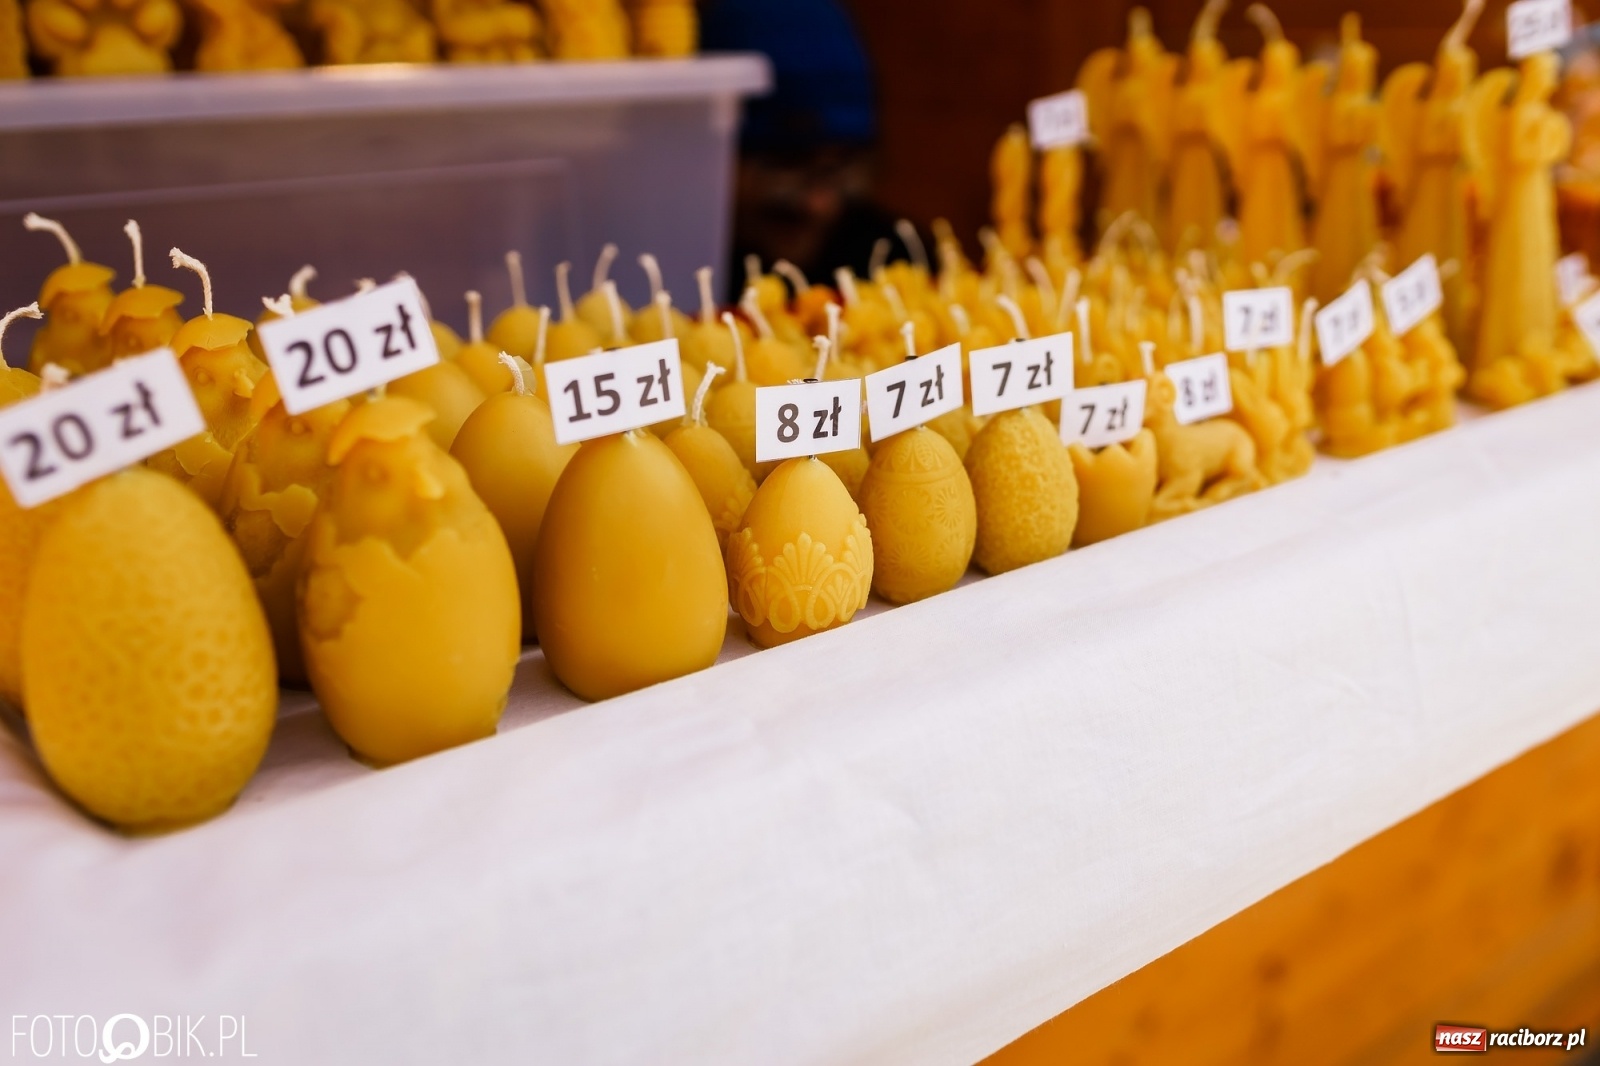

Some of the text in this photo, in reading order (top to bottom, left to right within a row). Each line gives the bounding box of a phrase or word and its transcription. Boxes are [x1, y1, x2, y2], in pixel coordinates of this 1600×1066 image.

[285, 303, 417, 390] 20 zł
[562, 358, 672, 423] 15 zł
[885, 363, 945, 420] 7 zł
[992, 350, 1054, 397] 7 zł
[1180, 369, 1218, 407] 8 zł
[9, 380, 163, 481] 20 zł
[776, 397, 842, 443] 8 zł
[1079, 396, 1130, 435] 7 zł
